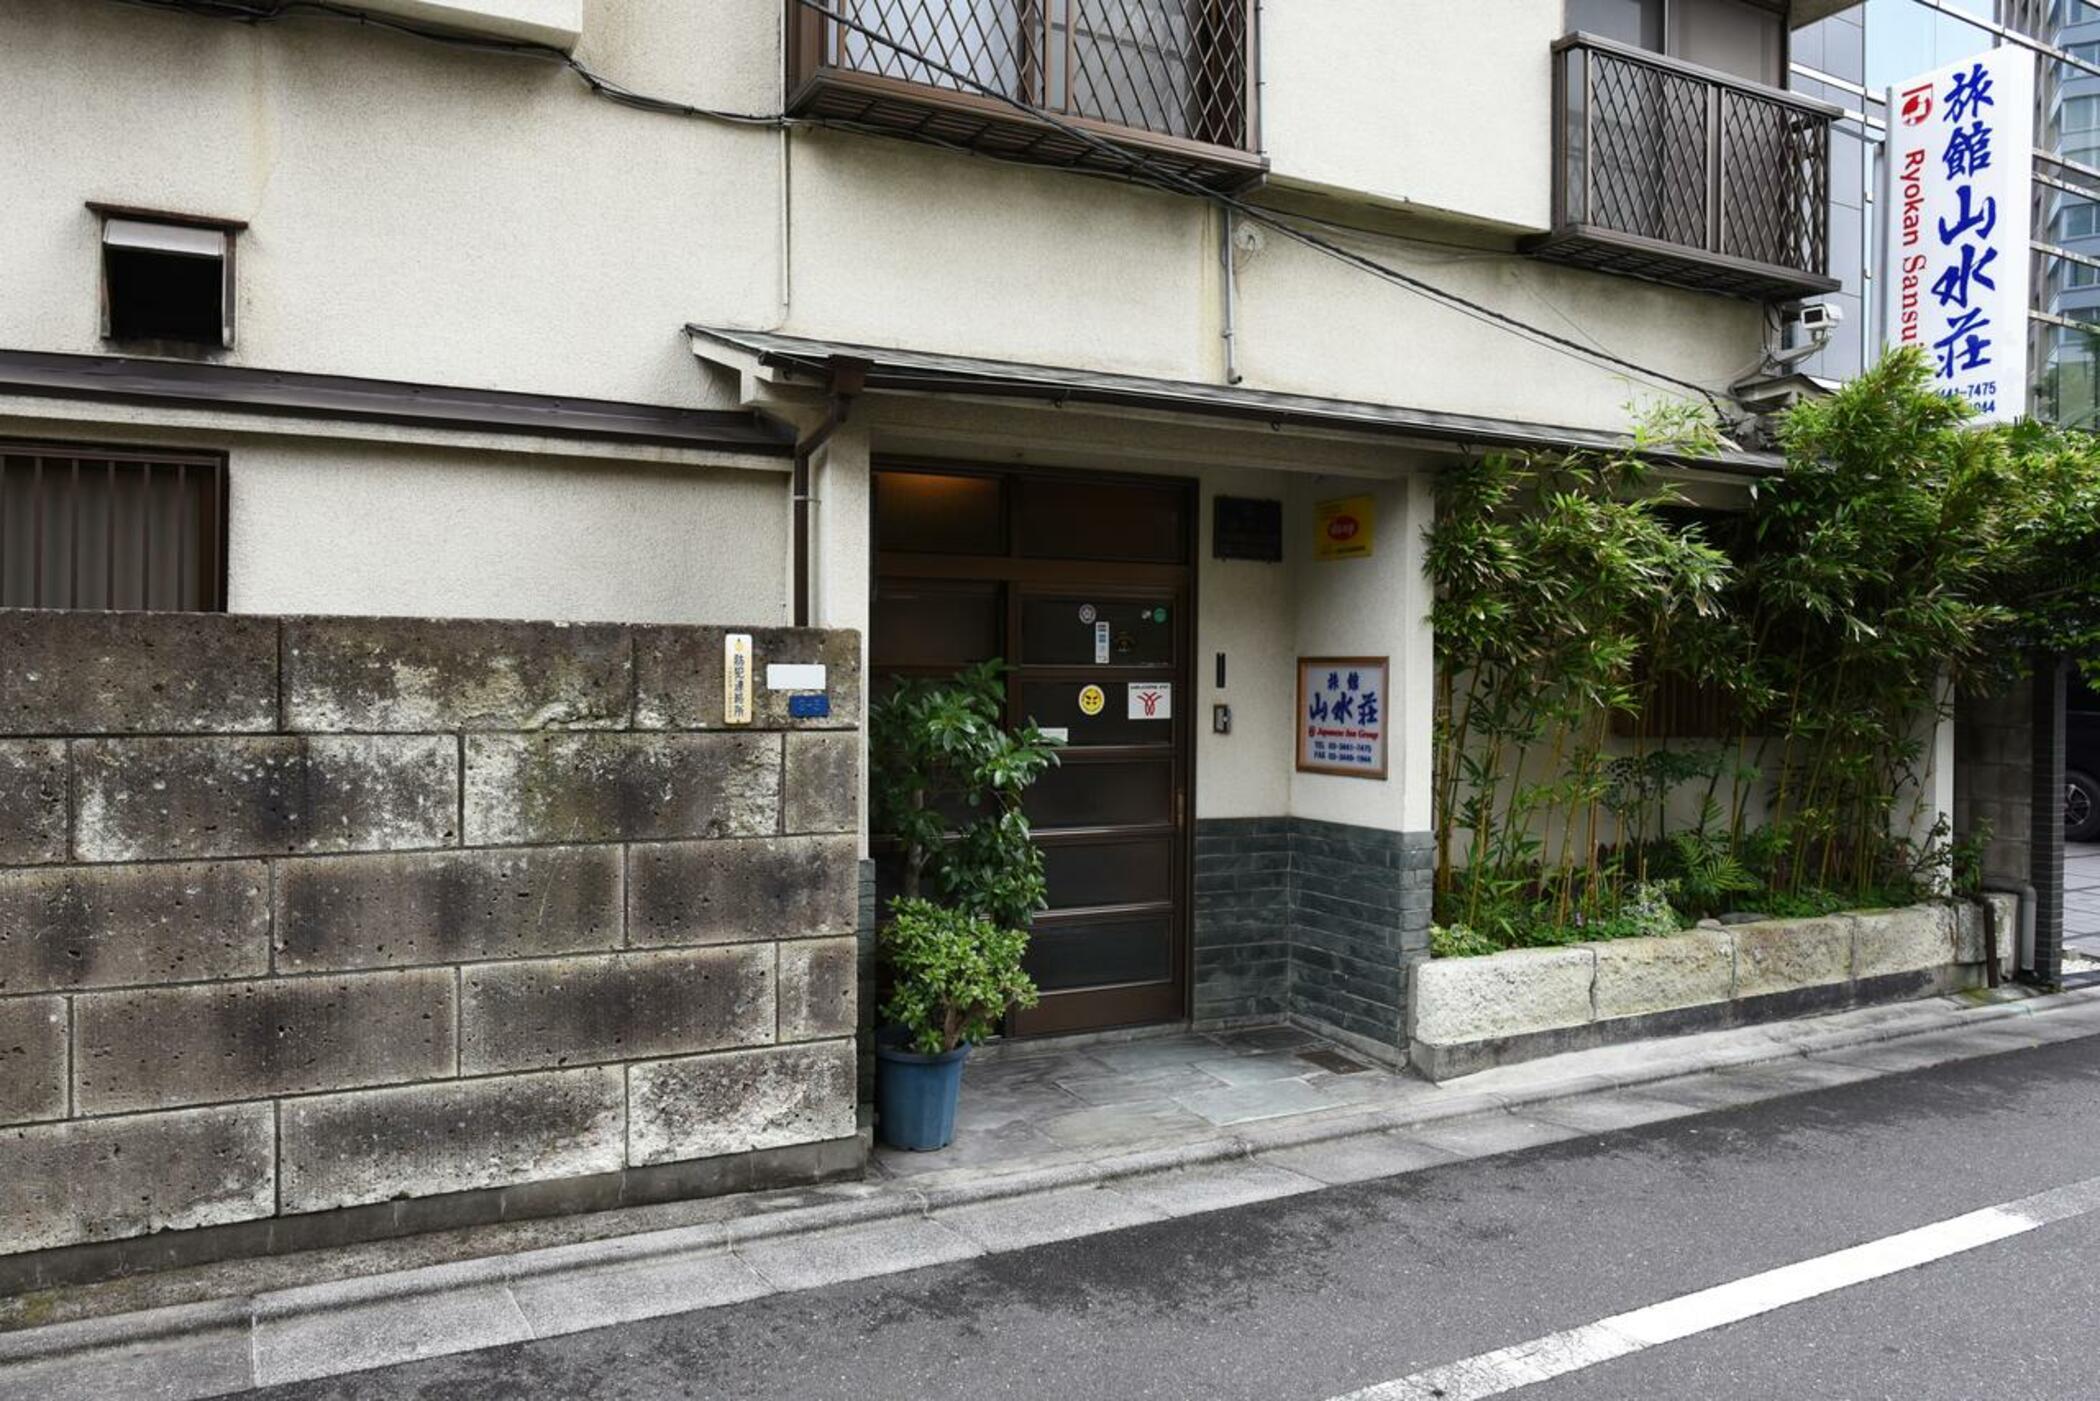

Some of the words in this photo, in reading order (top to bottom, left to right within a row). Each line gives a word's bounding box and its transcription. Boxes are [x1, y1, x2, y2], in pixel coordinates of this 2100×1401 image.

[1901, 149, 1926, 247] Ryokan
[1931, 63, 1998, 379] 旅館山水荘
[1309, 691, 1378, 725] 山水荘
